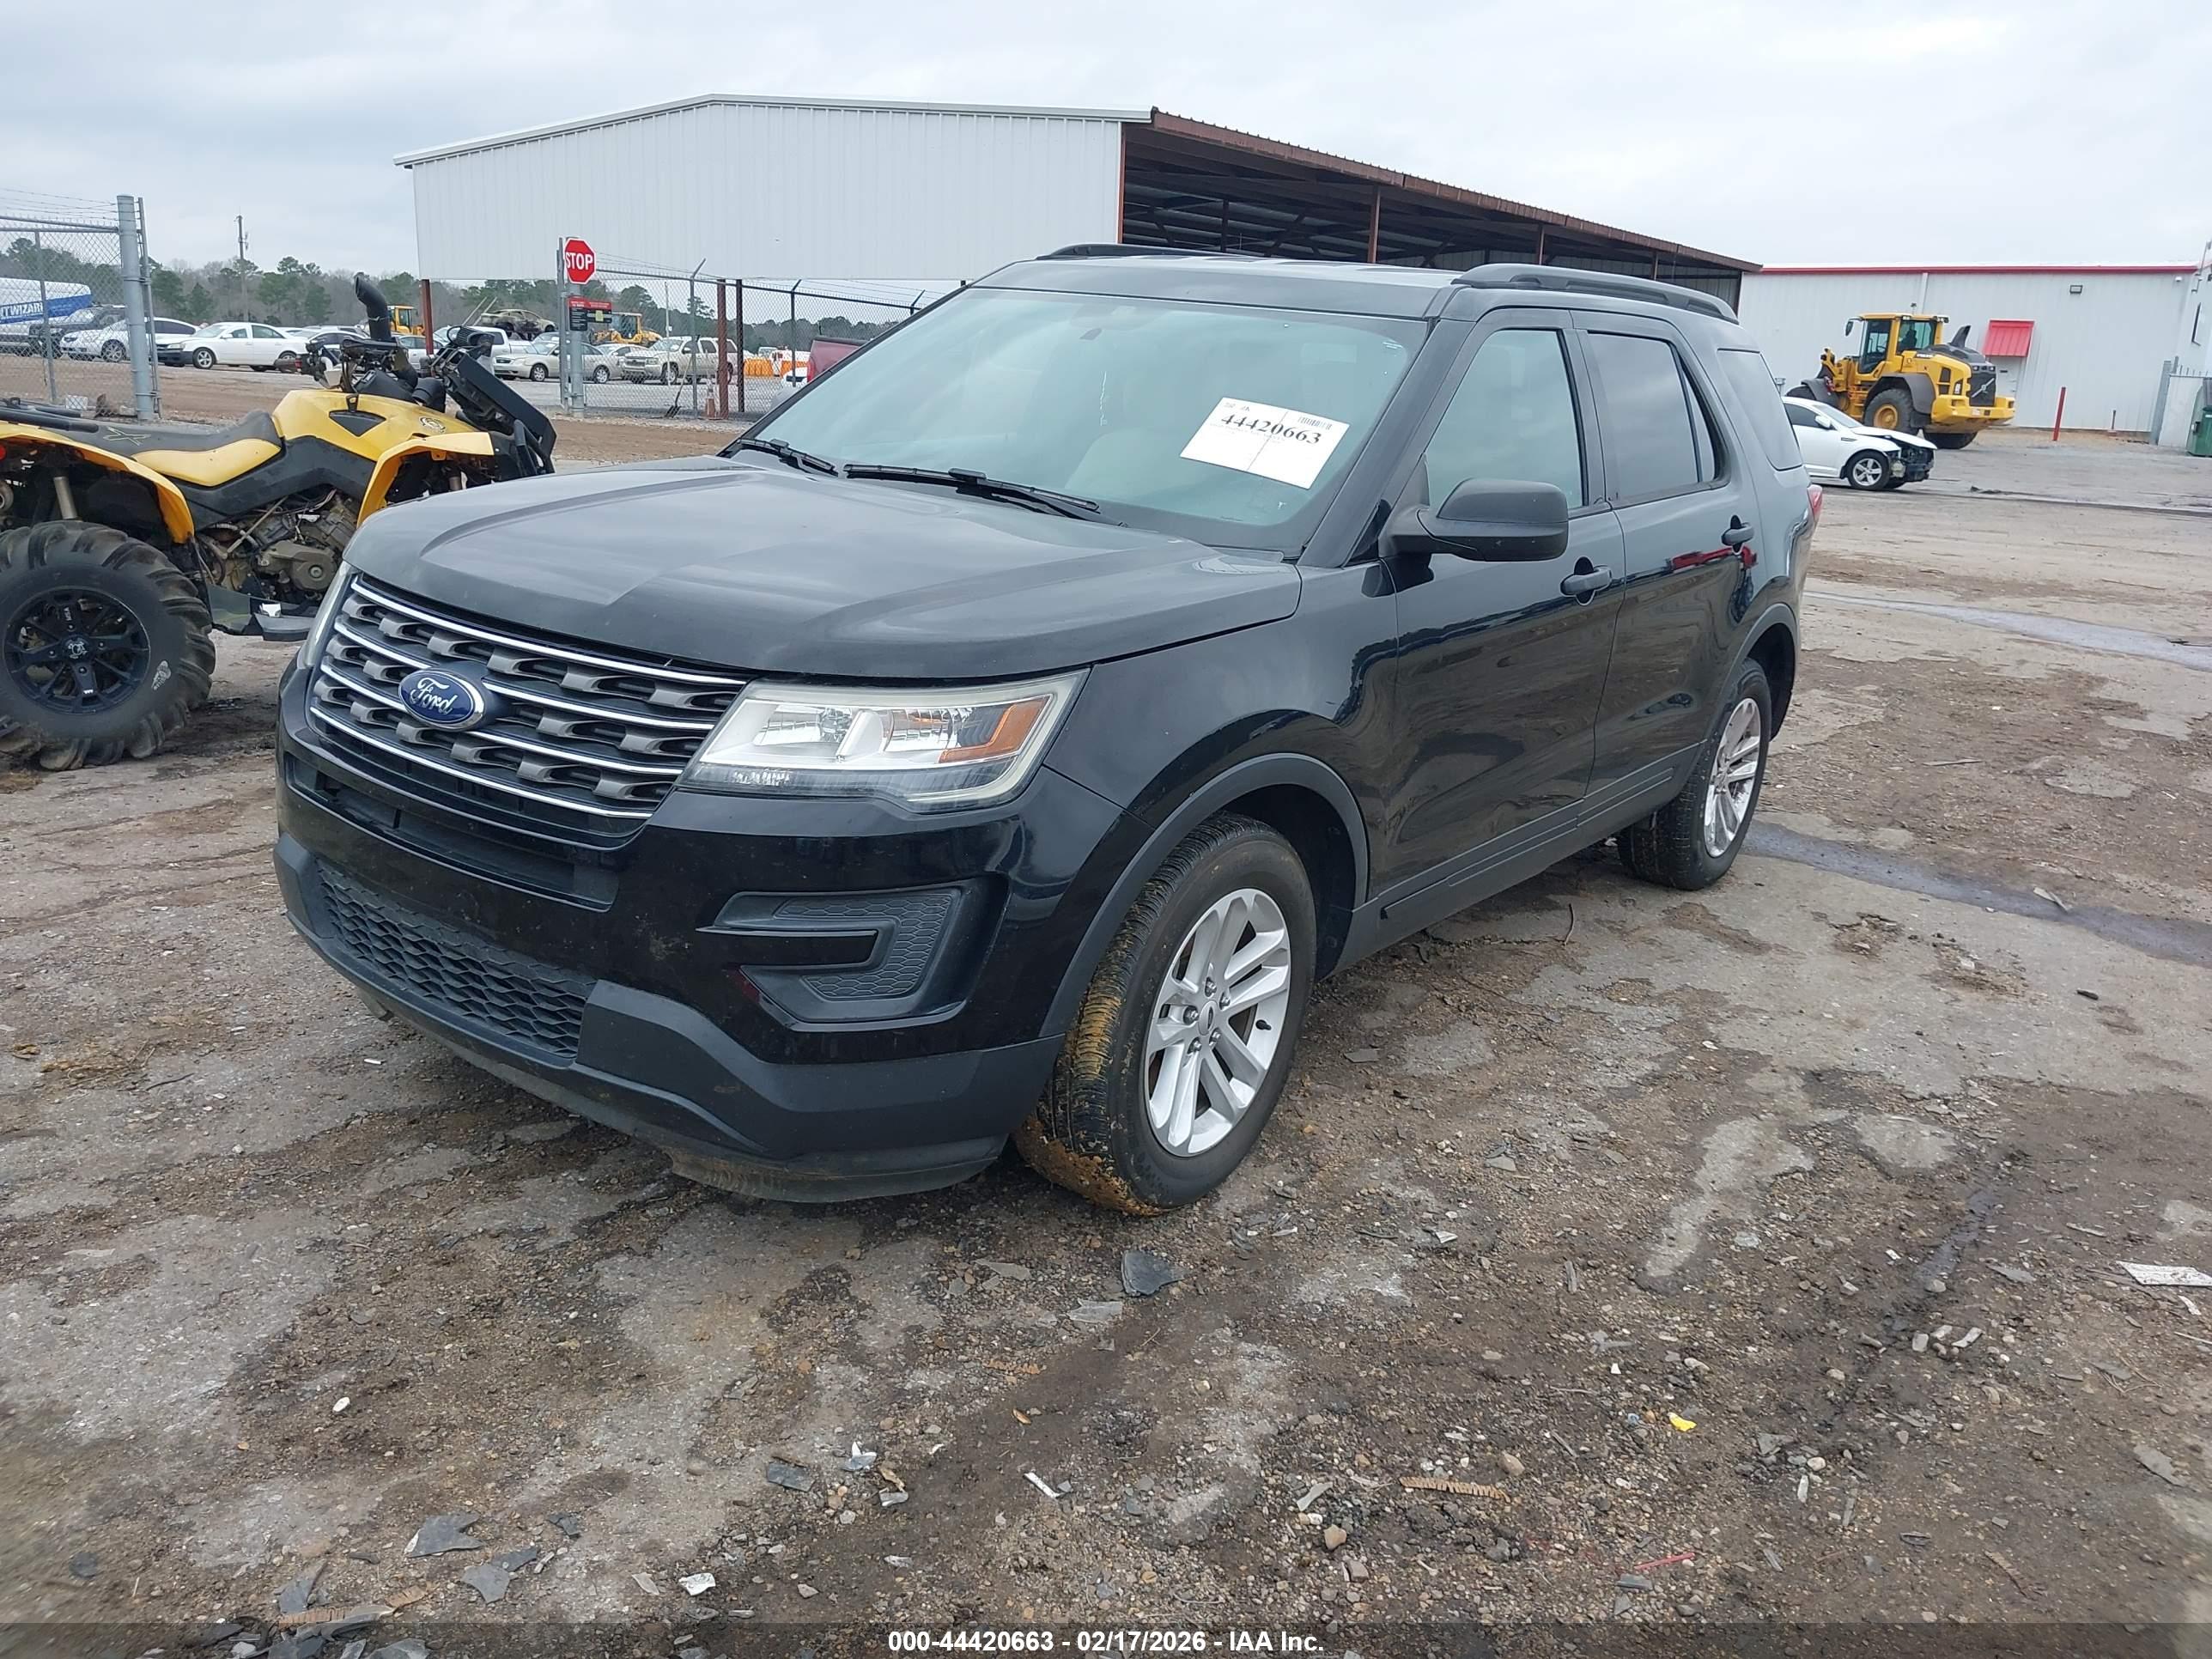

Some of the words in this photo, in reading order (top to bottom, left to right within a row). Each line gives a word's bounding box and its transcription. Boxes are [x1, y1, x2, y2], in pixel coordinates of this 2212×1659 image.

[566, 252, 592, 270] STOP
[1221, 414, 1322, 444] 44420663
[410, 677, 459, 714] Ford
